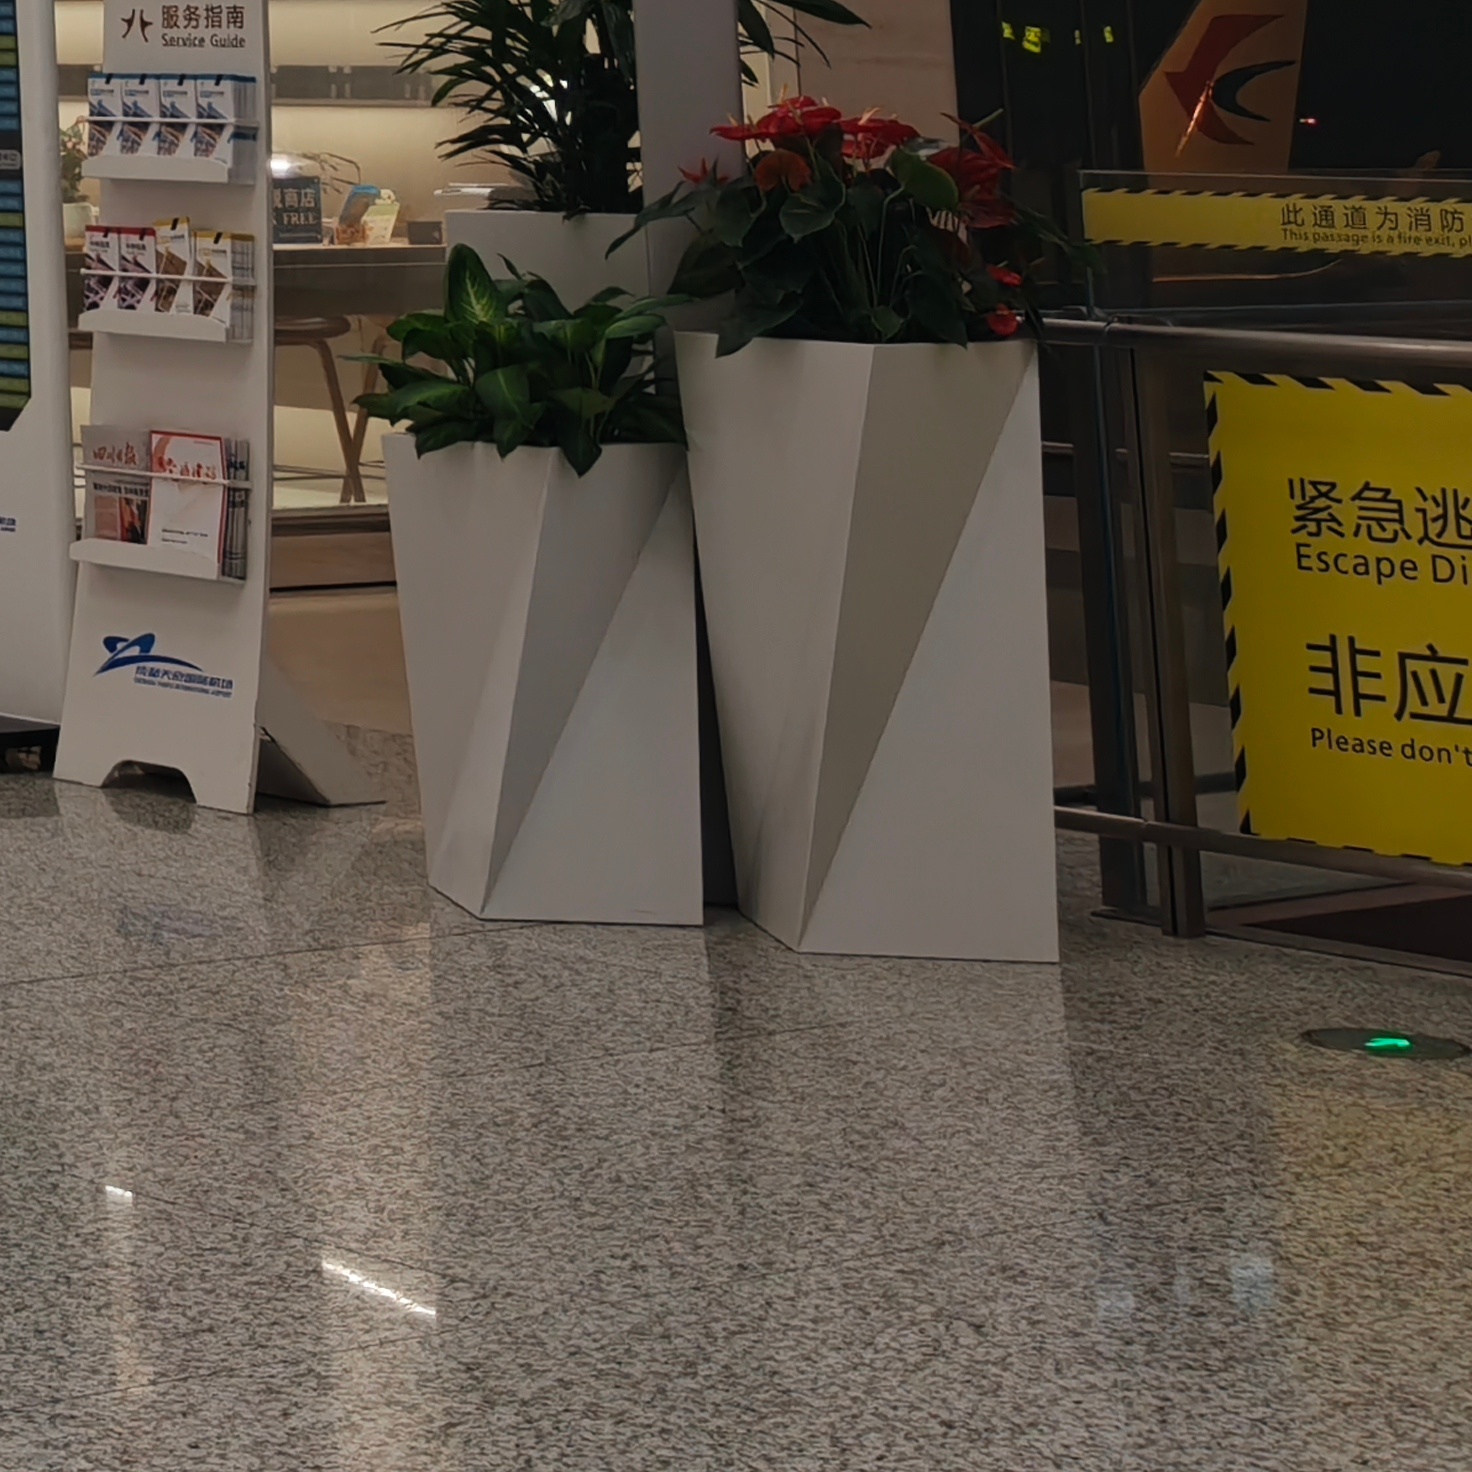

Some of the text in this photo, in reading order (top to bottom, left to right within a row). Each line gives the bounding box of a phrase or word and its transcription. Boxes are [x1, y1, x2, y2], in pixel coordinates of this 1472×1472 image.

[161, 3, 245, 30] 服务指南
[161, 32, 246, 49] Service Guide
[1280, 202, 1466, 234] 此通道为消防
[1281, 227, 1309, 242] This
[1312, 230, 1369, 246] passage
[1372, 232, 1383, 244] is
[1397, 231, 1423, 246] fire
[1286, 477, 1472, 551] 紧急逃
[1295, 541, 1419, 586] Escape
[1305, 632, 1472, 726] 非应
[1309, 727, 1472, 768] Please don't
